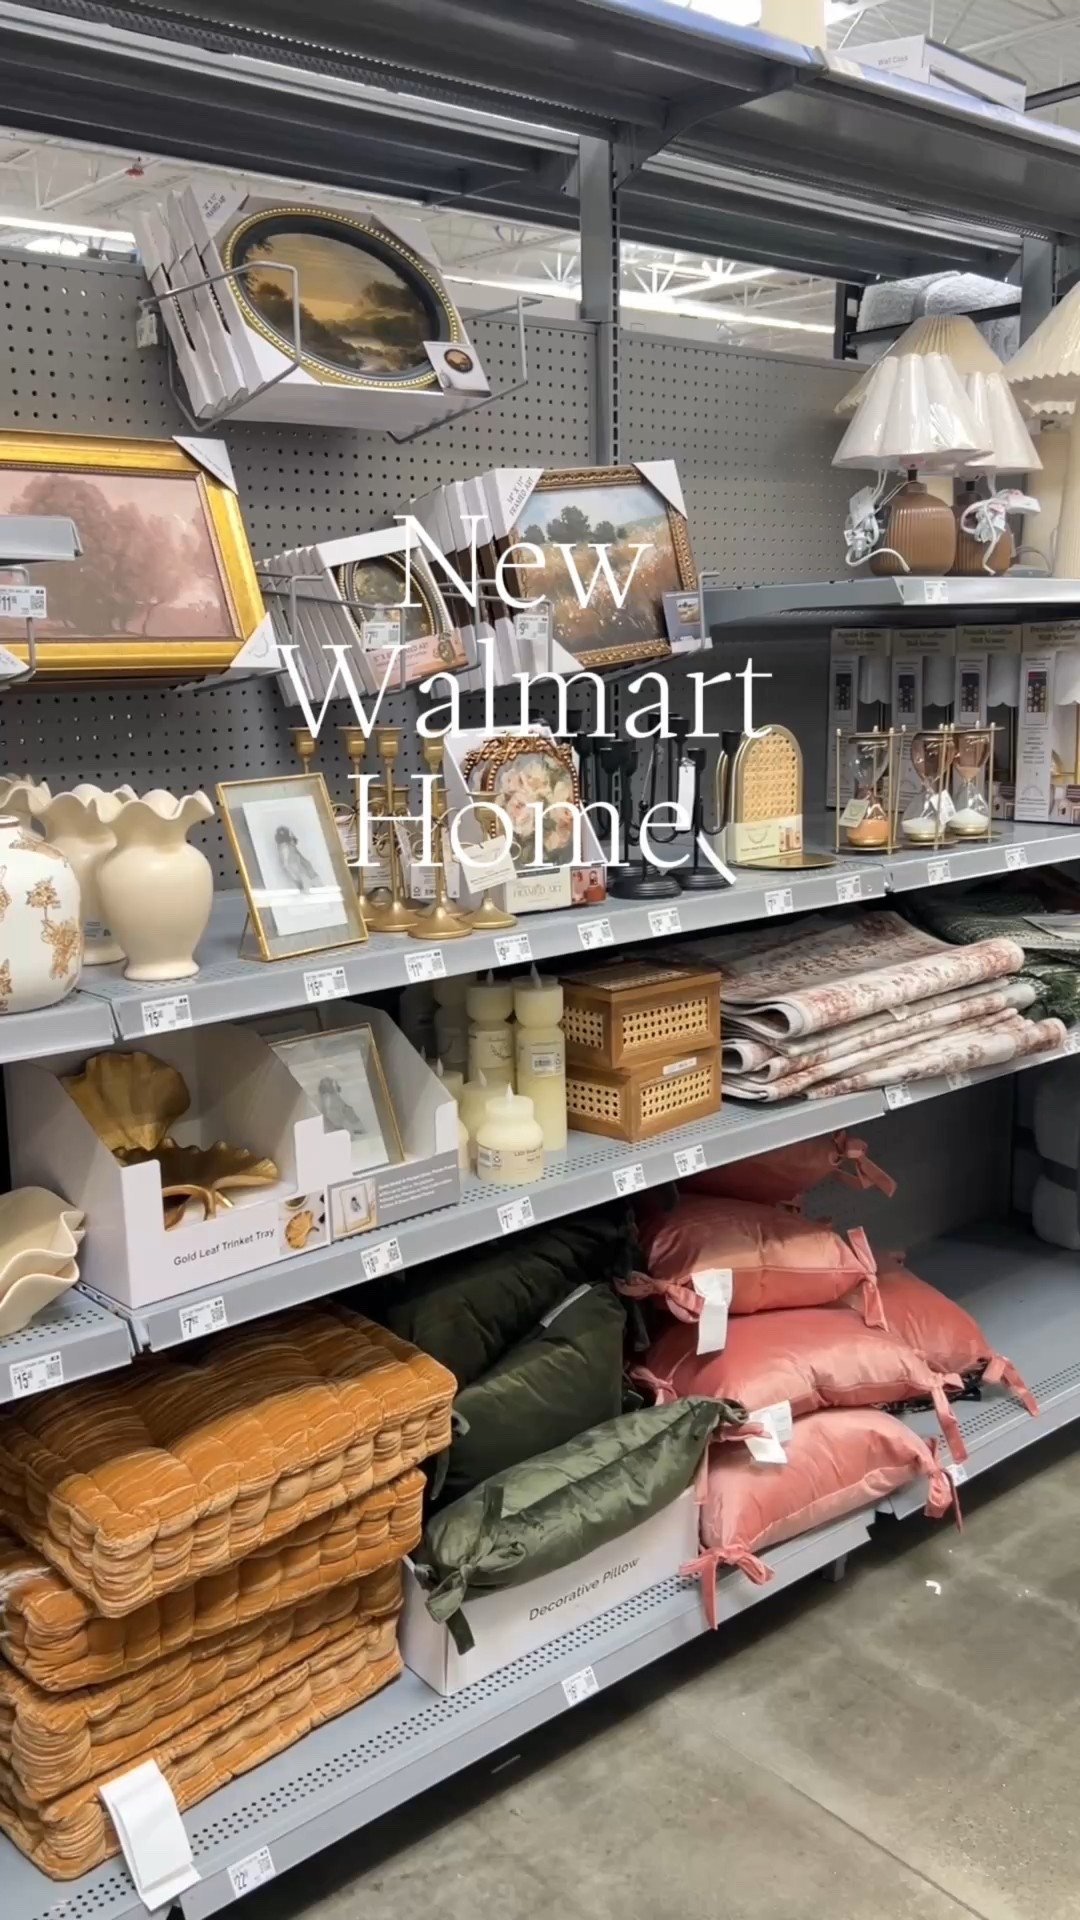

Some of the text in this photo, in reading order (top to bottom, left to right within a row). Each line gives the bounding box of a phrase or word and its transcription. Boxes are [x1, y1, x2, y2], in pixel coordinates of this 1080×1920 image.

[173, 1228, 275, 1266] Gold Leaf Trinket Tray
[528, 1557, 640, 1621] Decorative Pillow
